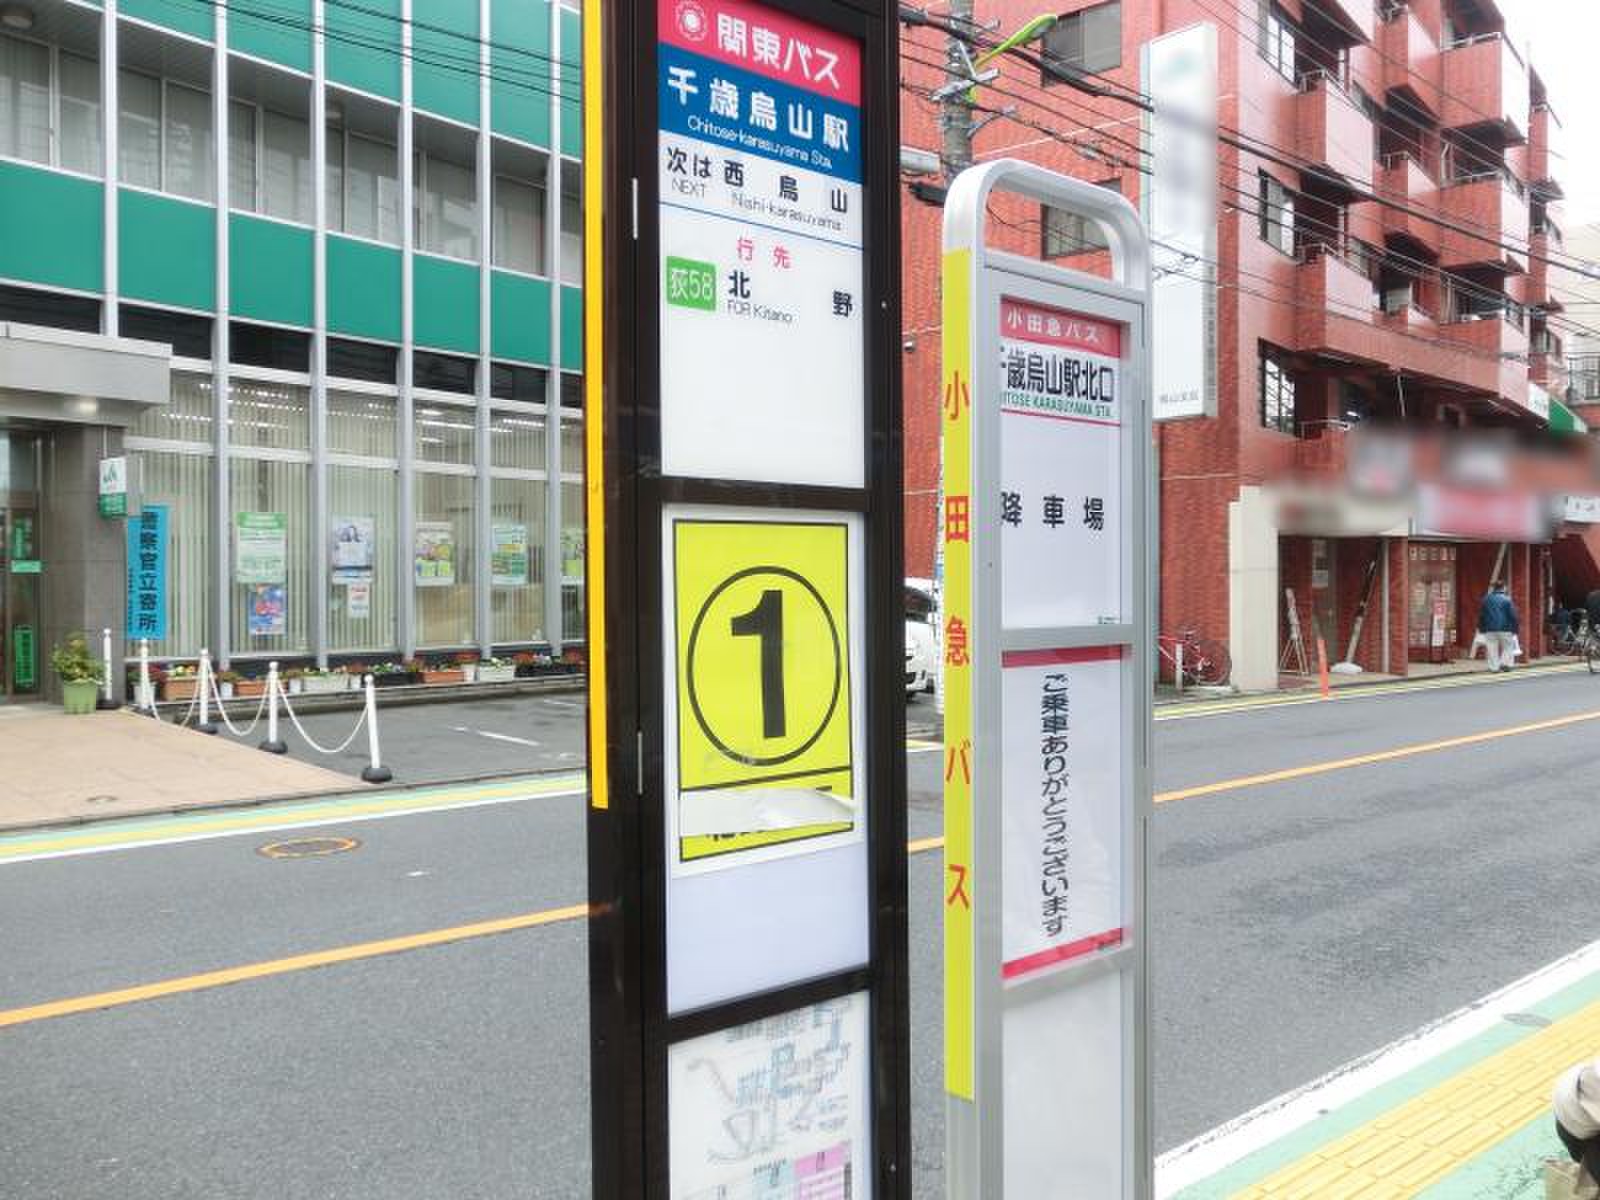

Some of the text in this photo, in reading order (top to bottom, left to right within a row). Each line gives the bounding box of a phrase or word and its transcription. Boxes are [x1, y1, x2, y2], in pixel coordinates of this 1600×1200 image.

[716, 12, 840, 90] 関東バス
[667, 146, 712, 179] 次は
[671, 178, 706, 198] NEXT
[736, 236, 791, 270] 行先
[727, 299, 794, 323] FOR Kitano
[1007, 305, 1100, 343] 小田急バス
[1000, 345, 1115, 402] 歳烏山駅北口
[944, 370, 971, 911] 小田急バス
[1041, 672, 1070, 938] ご乗車ありがとうございます
